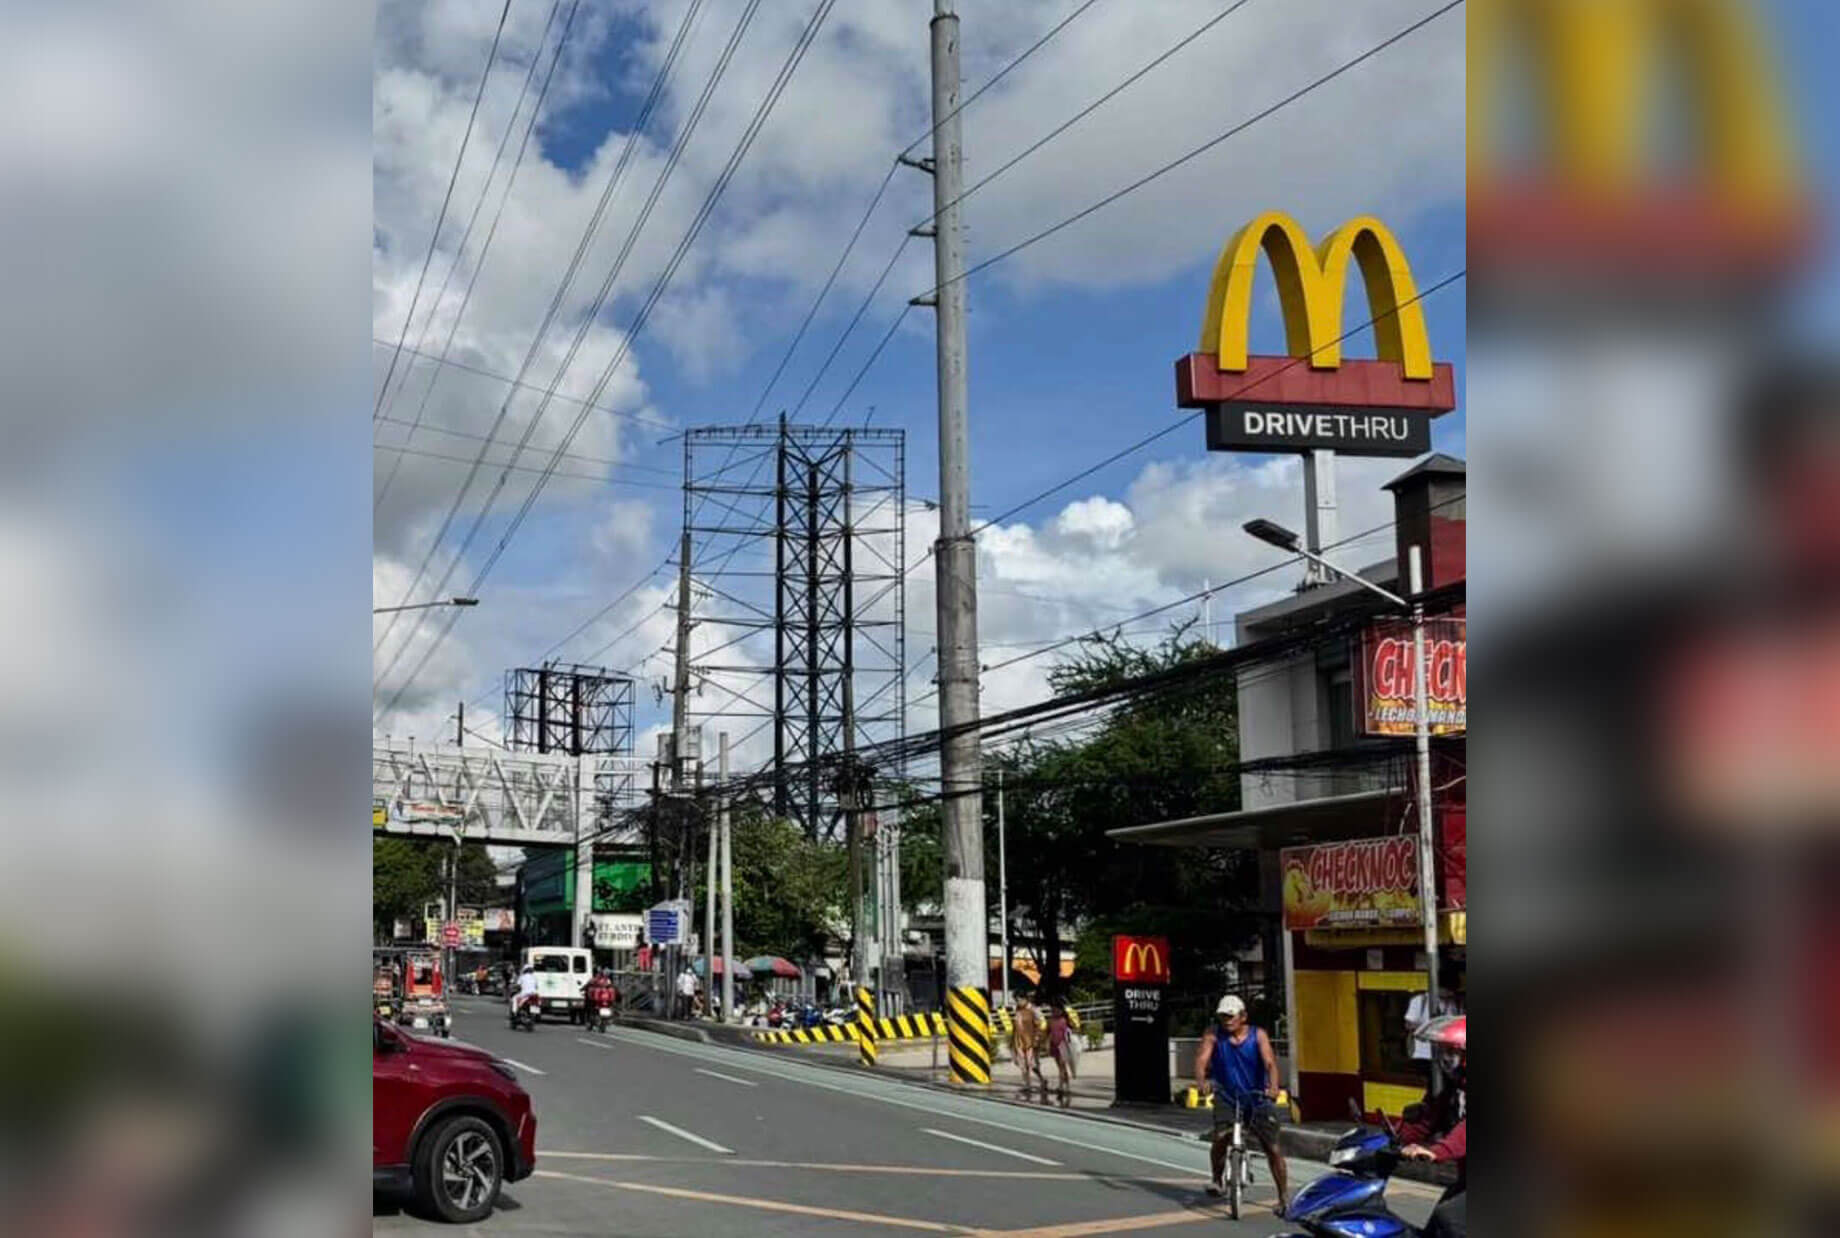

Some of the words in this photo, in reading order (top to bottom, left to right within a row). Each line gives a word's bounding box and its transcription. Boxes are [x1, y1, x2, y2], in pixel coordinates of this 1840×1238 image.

[1243, 411, 1409, 441] DRIVETHRU
[1125, 988, 1160, 1000] DRIVE
[1129, 1000, 1158, 1011] THRU
